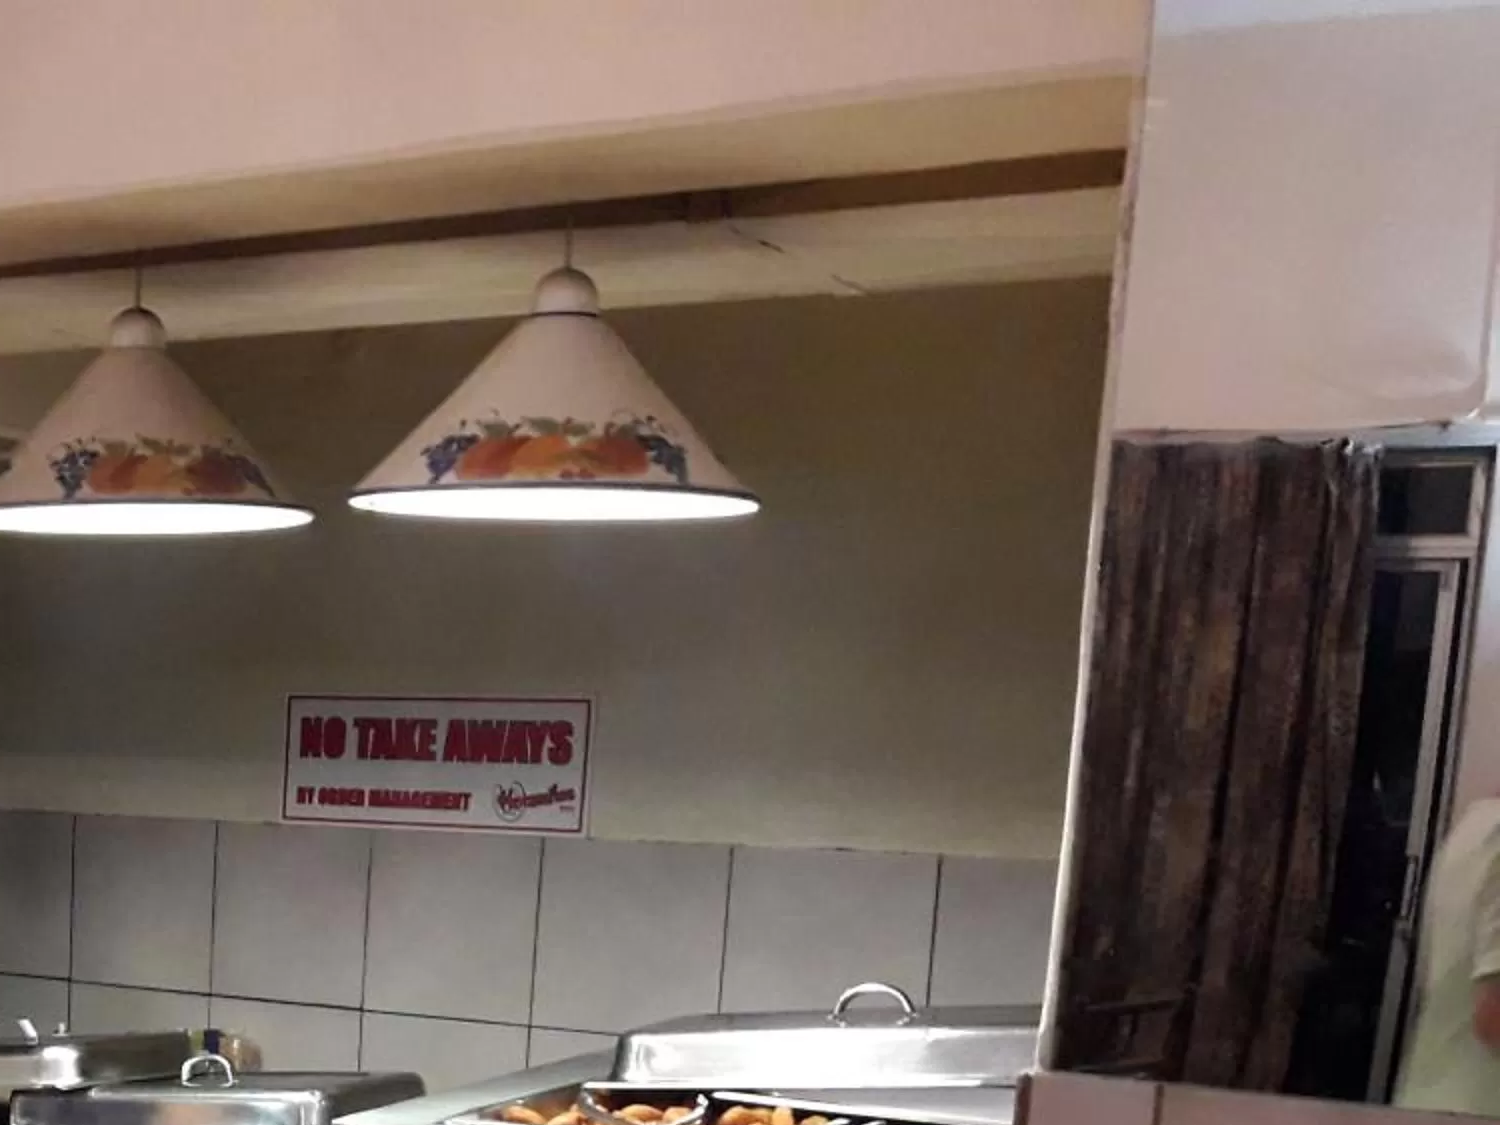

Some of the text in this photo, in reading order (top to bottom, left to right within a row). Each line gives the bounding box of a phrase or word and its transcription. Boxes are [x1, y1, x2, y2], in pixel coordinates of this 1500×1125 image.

[300, 716, 574, 765] NO TAKE AWAYS
[296, 786, 315, 805] BY
[368, 789, 472, 812] MANAGEMENT
